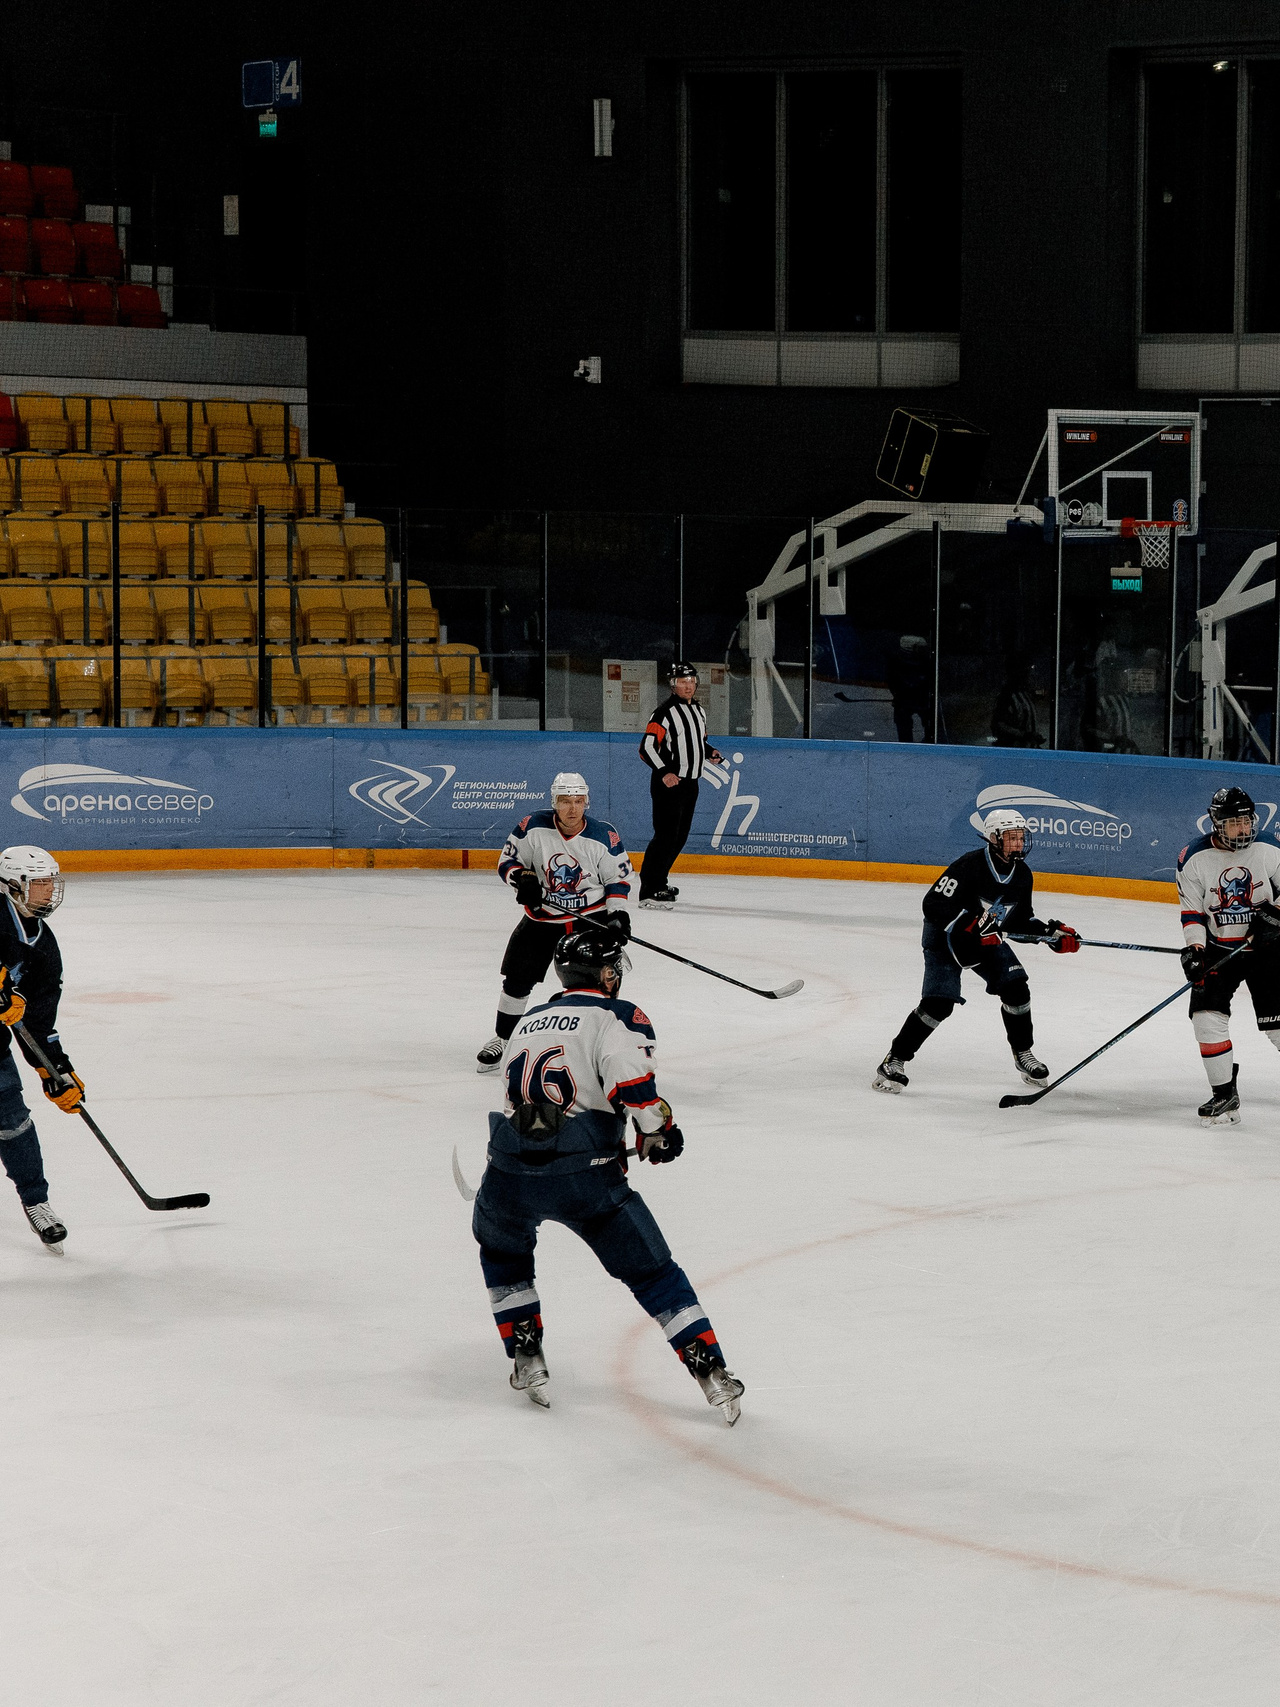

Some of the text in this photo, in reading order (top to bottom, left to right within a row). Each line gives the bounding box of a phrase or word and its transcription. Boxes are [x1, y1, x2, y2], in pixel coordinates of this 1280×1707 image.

[280, 60, 299, 100] 4
[1066, 432, 1090, 440] WINLINE
[1160, 433, 1184, 441] WINLINE
[1069, 508, 1082, 516] РФБ
[1112, 579, 1141, 592] ВЫХОД
[453, 781, 528, 791] РЕГИОНАЛЬНЫЙ
[452, 791, 545, 800] ЦЕНТР СПОРТИВНЫХ
[451, 800, 515, 810] СООРУЖЕНИЙ
[62, 816, 201, 825] СПОРТИВНЫЙ КОМПЛЕКС
[748, 832, 848, 846] МИНИСТЕРСТВО СПОРТА
[721, 844, 810, 856] КРАСНОЯРСКОГО КРАЯ
[1075, 843, 1122, 852] КОМПЛЕКС
[934, 876, 958, 898] 98
[518, 1015, 581, 1035] КОЗЛОВ
[505, 1045, 578, 1116] 16
